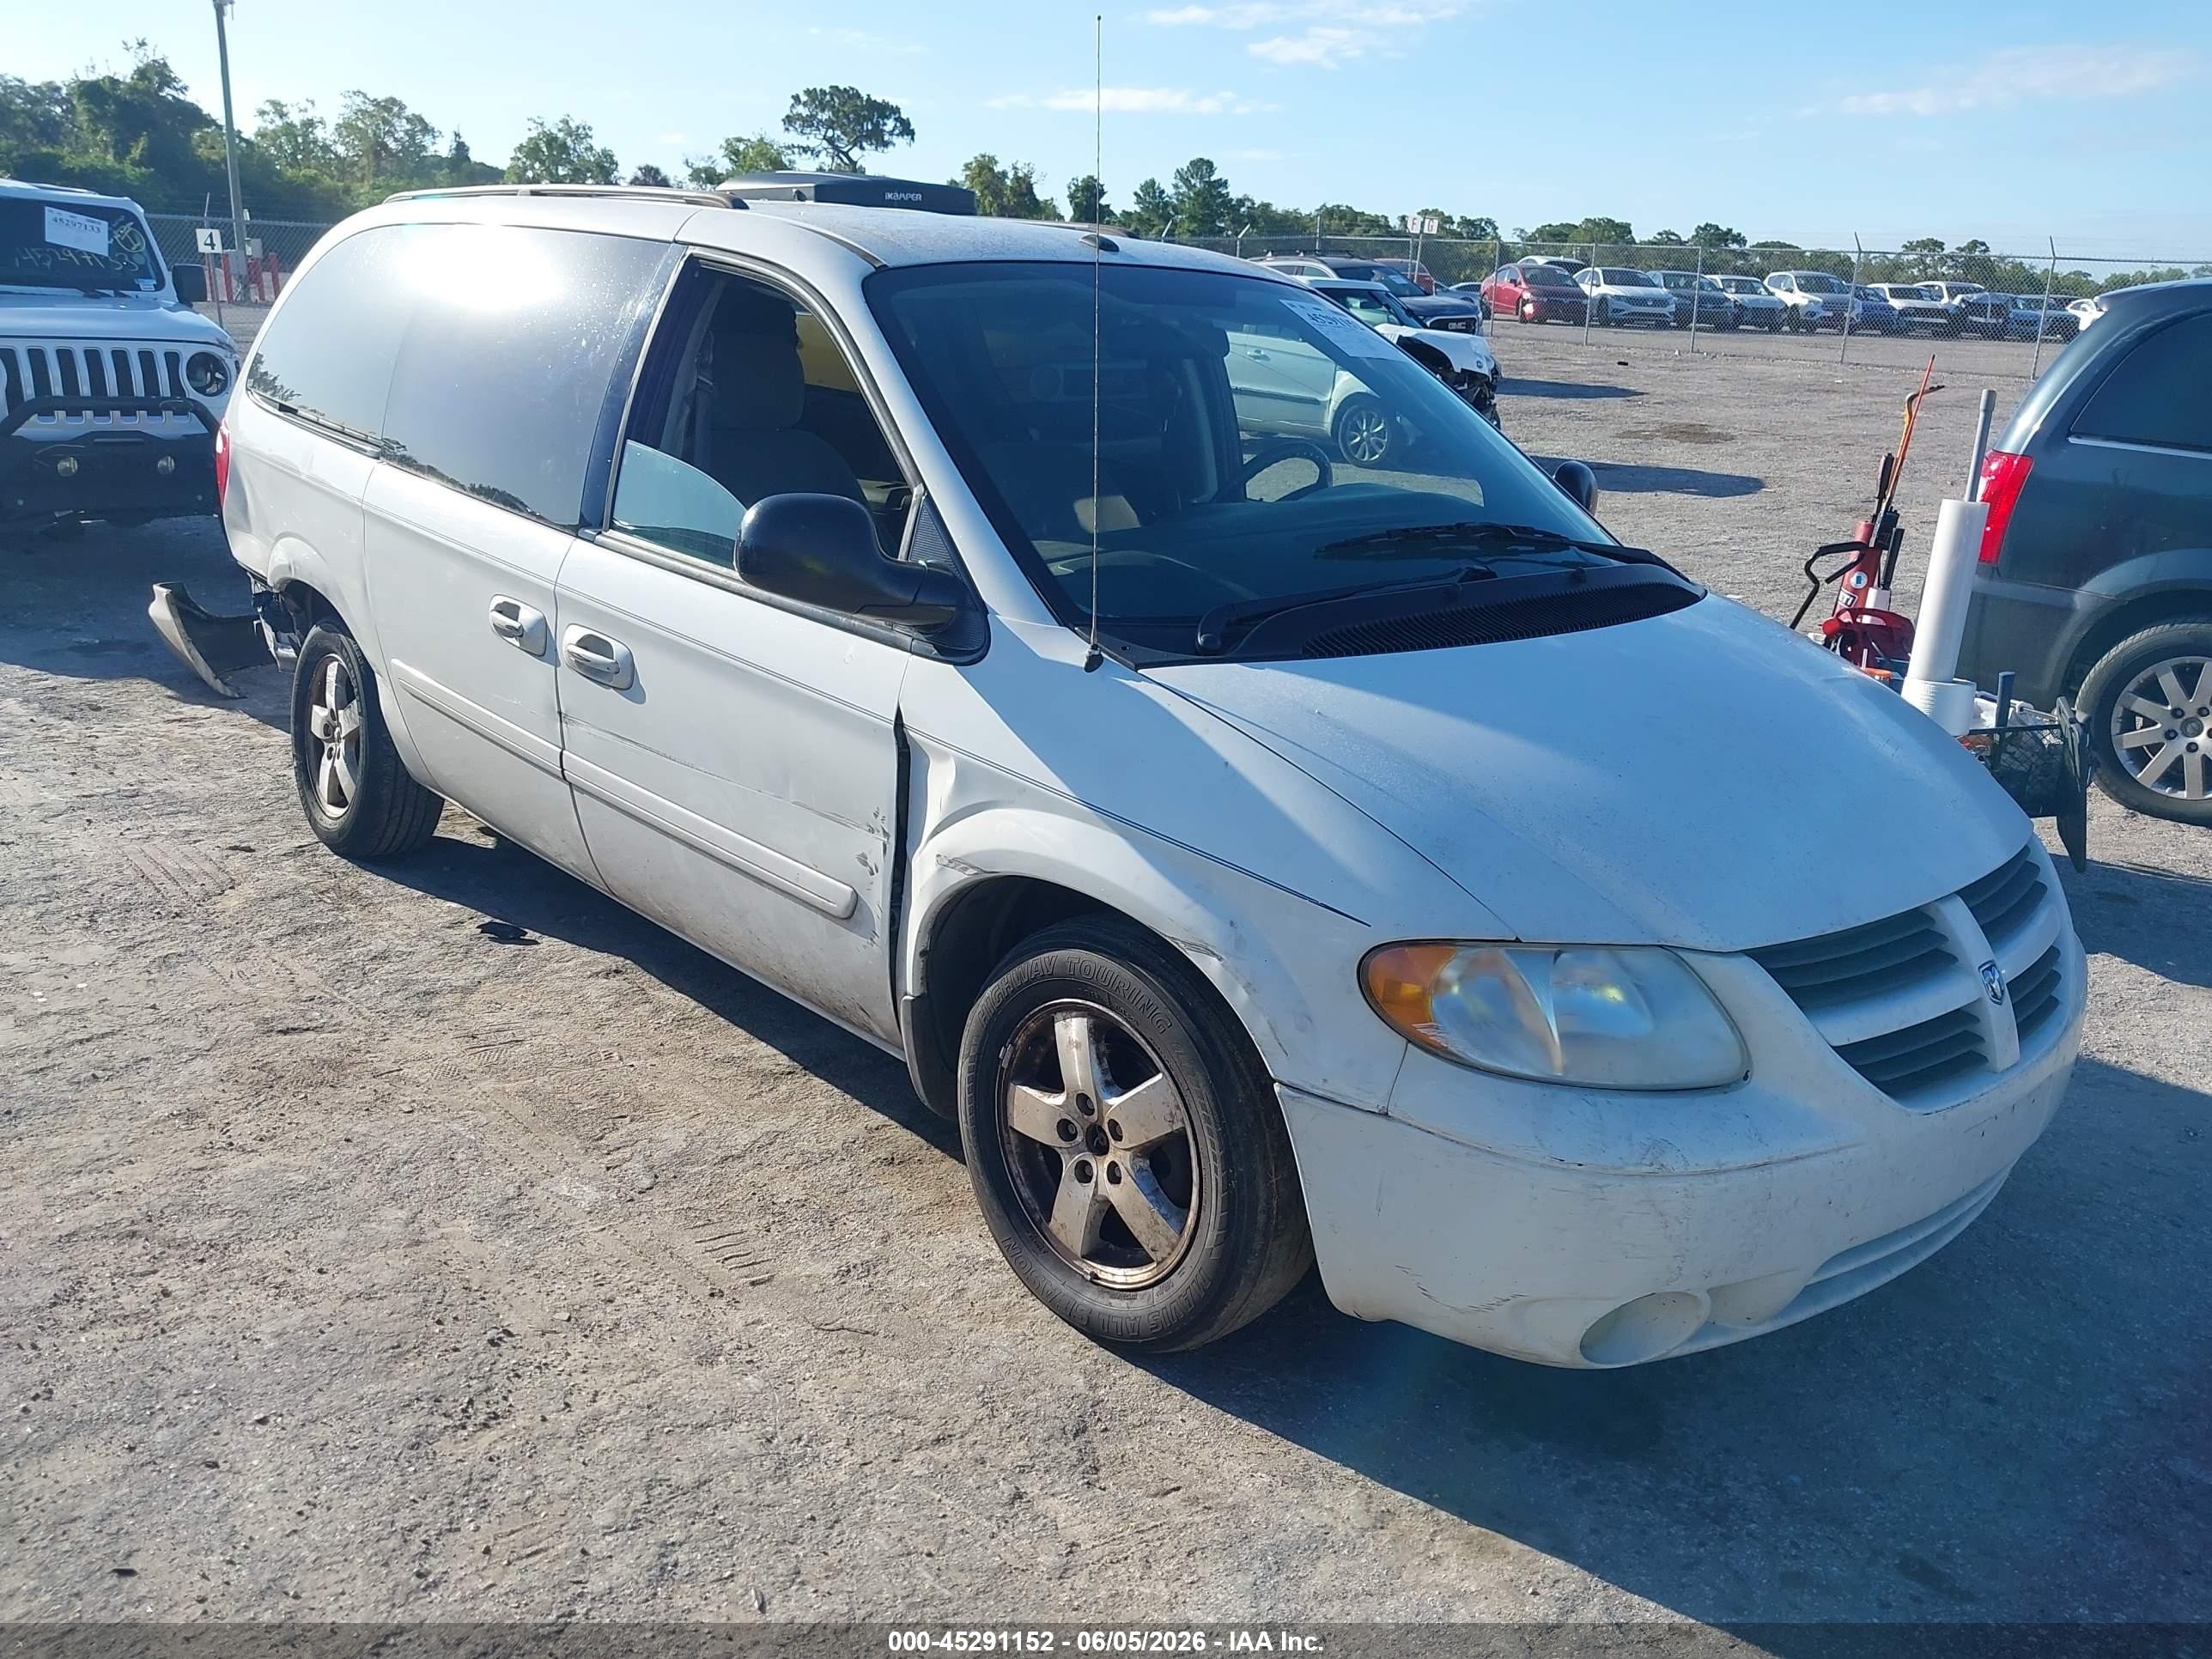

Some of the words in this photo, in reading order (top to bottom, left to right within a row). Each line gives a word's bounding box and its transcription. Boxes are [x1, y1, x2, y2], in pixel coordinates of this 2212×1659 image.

[52, 216, 101, 234] 45297133
[204, 231, 216, 251] 4
[1448, 321, 1467, 330] GMC
[979, 955, 1058, 1029] HIGHWAY
[1066, 955, 1173, 1034] TOURING
[1001, 1237, 1093, 1327] SEASON
[1147, 1267, 1212, 1334] MAVIS
[1098, 1313, 1142, 1336] ALL
